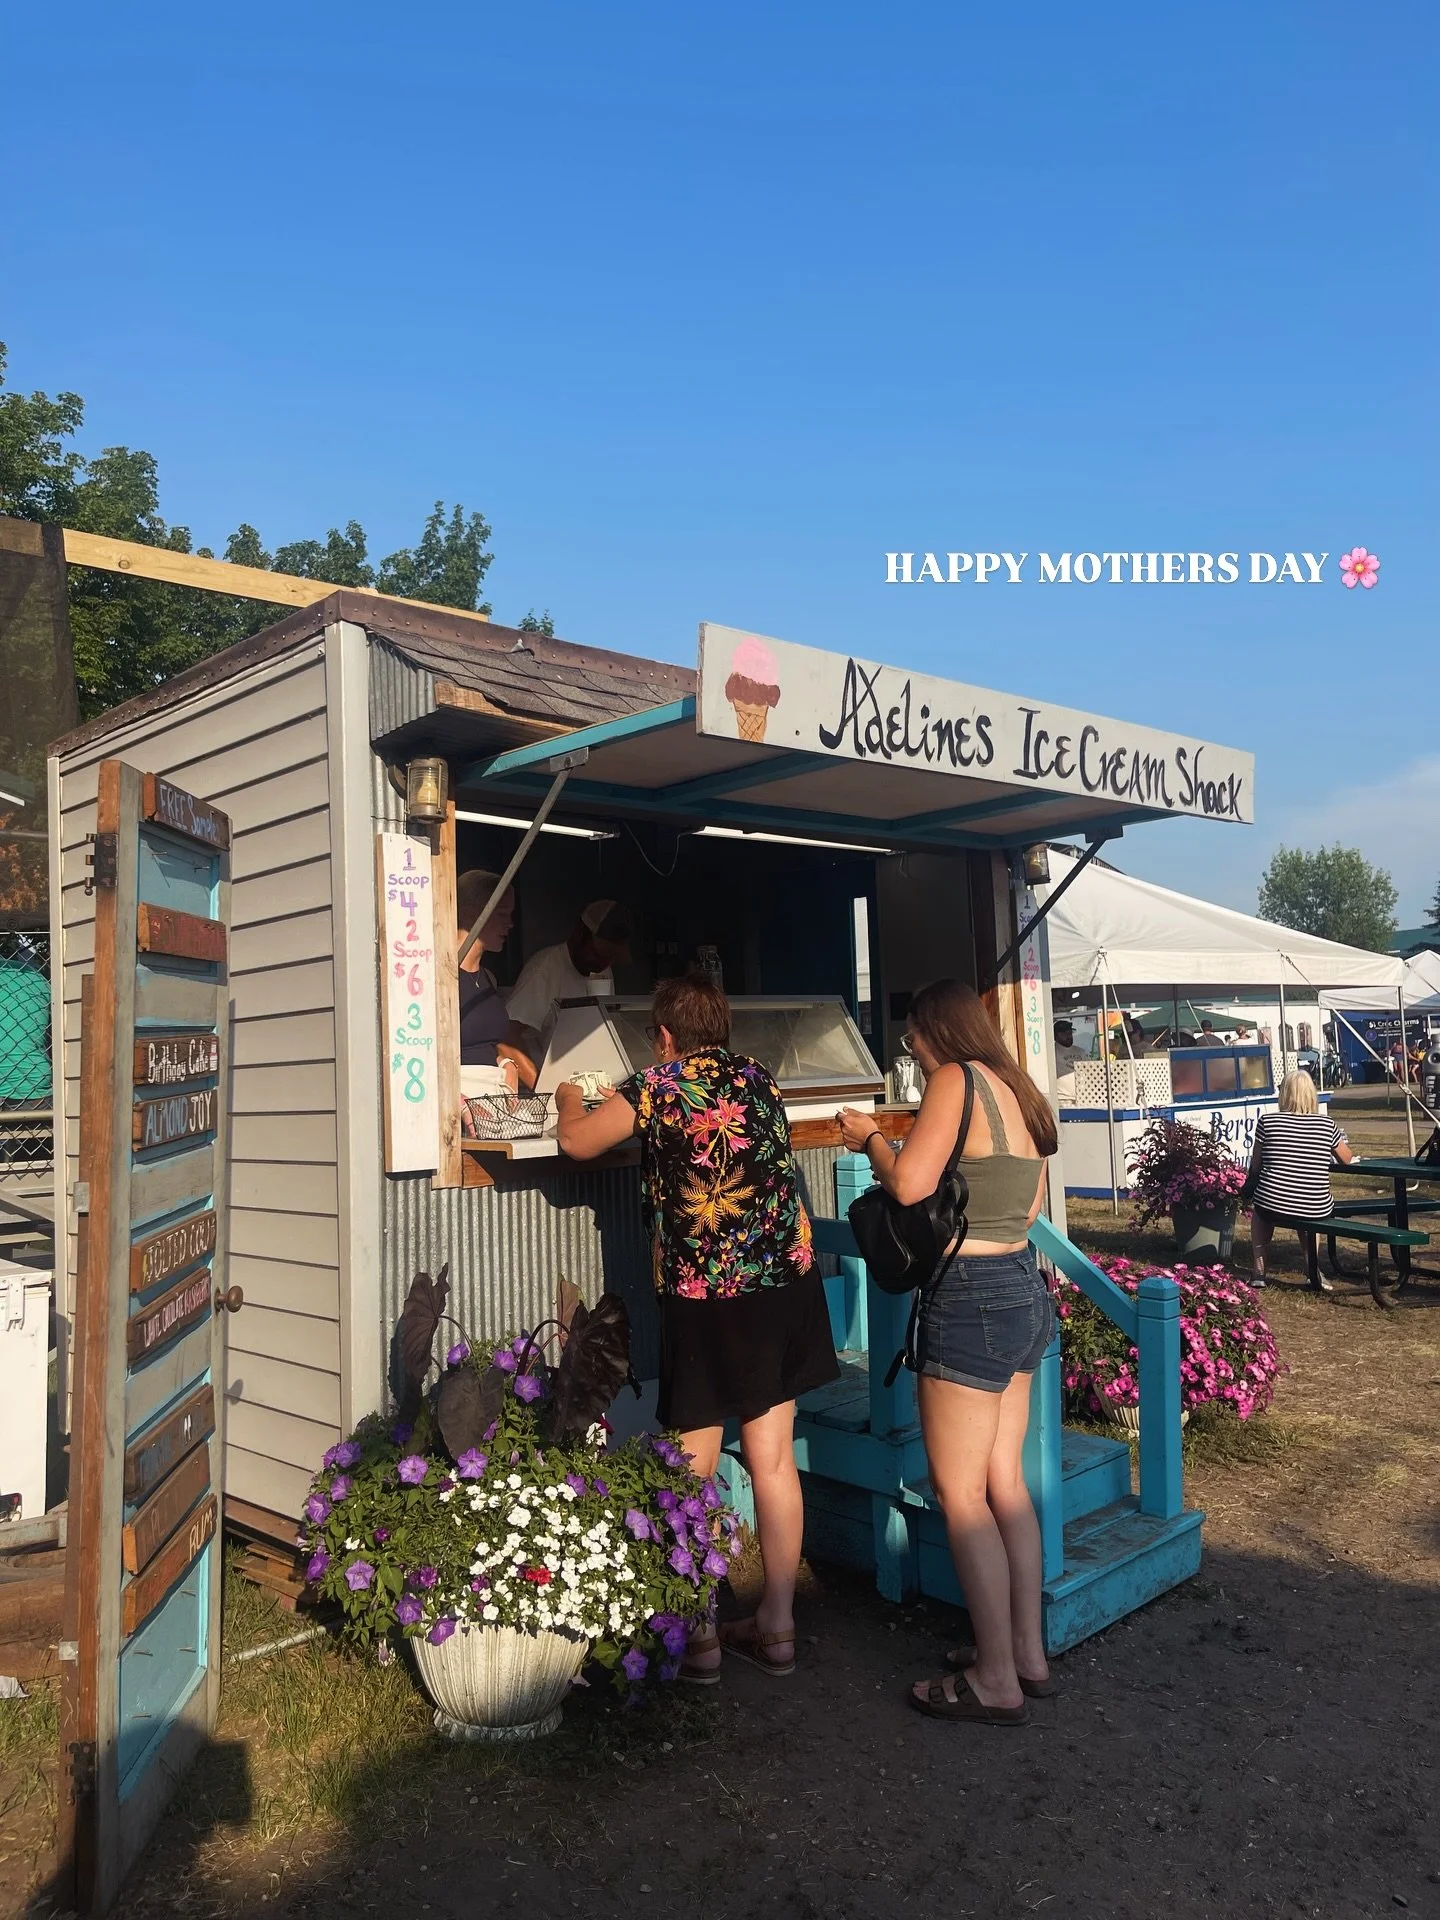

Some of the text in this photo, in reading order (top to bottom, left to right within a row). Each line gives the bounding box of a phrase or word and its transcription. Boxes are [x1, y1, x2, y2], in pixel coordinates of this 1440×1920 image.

[1174, 745, 1244, 821] Shack
[403, 848, 417, 871] 1
[388, 874, 430, 889] Scoop
[388, 889, 418, 917] $4
[1024, 895, 1031, 910] 1
[405, 919, 420, 942] 2
[393, 940, 433, 962] Scoop
[1028, 946, 1035, 961] 2
[393, 962, 424, 997] $6
[1030, 996, 1037, 1013] 3
[407, 1002, 423, 1031] 3
[395, 1028, 433, 1051] Scoop
[392, 1052, 426, 1103] $8
[145, 1091, 212, 1146] ALMOND JOY
